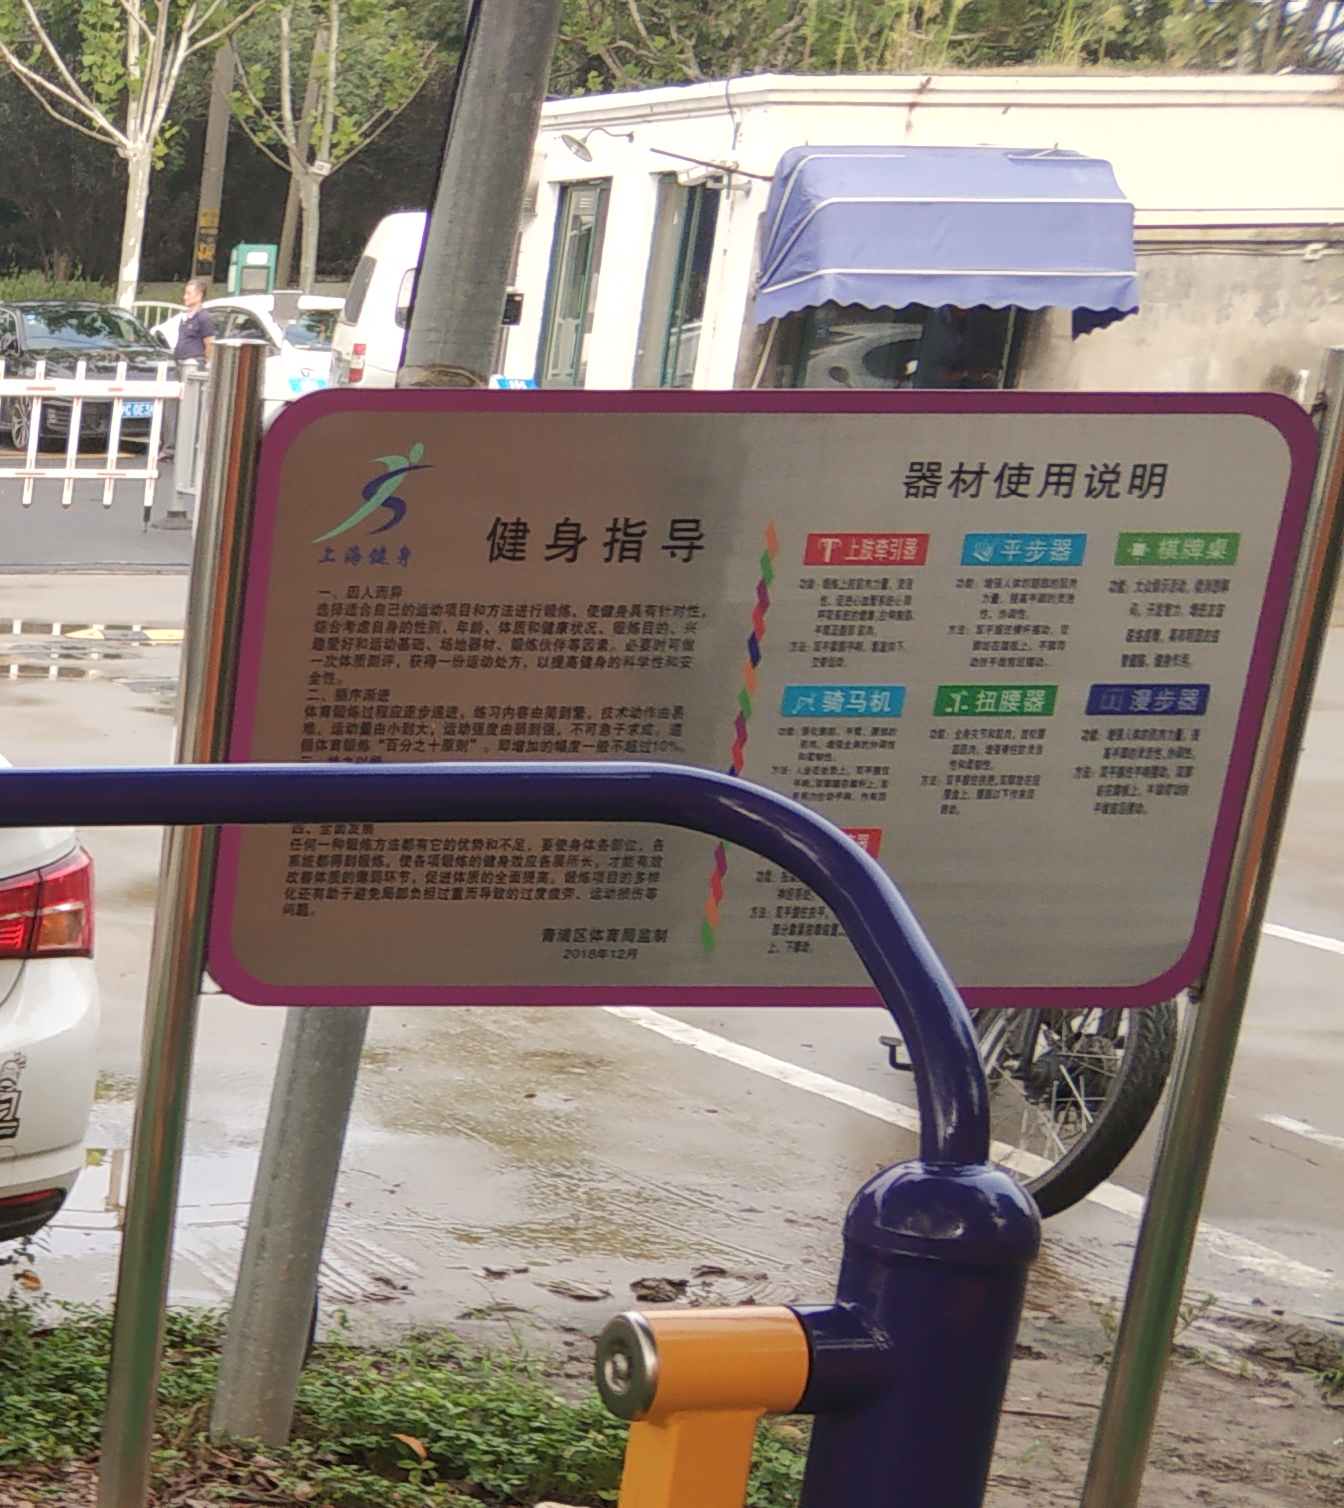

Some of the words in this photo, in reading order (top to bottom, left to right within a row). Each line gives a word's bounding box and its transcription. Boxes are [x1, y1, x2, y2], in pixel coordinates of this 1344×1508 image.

[902, 461, 1169, 500] 器材使用说明
[487, 516, 705, 563] 健身指导
[844, 537, 919, 560] 上肢牵引器
[1000, 538, 1073, 562] 平步器
[1157, 537, 1227, 560] 棋牌桌
[318, 545, 411, 567] 上海健身
[319, 585, 403, 600] 一、因人而异
[306, 688, 390, 702] 二、循序渐进
[821, 690, 892, 713] 骑马机
[975, 690, 1047, 713] 扭腰器
[1130, 689, 1200, 713] 漫步器
[541, 927, 669, 944] 青浦区体育局监制
[562, 948, 638, 961] 2018年12月
